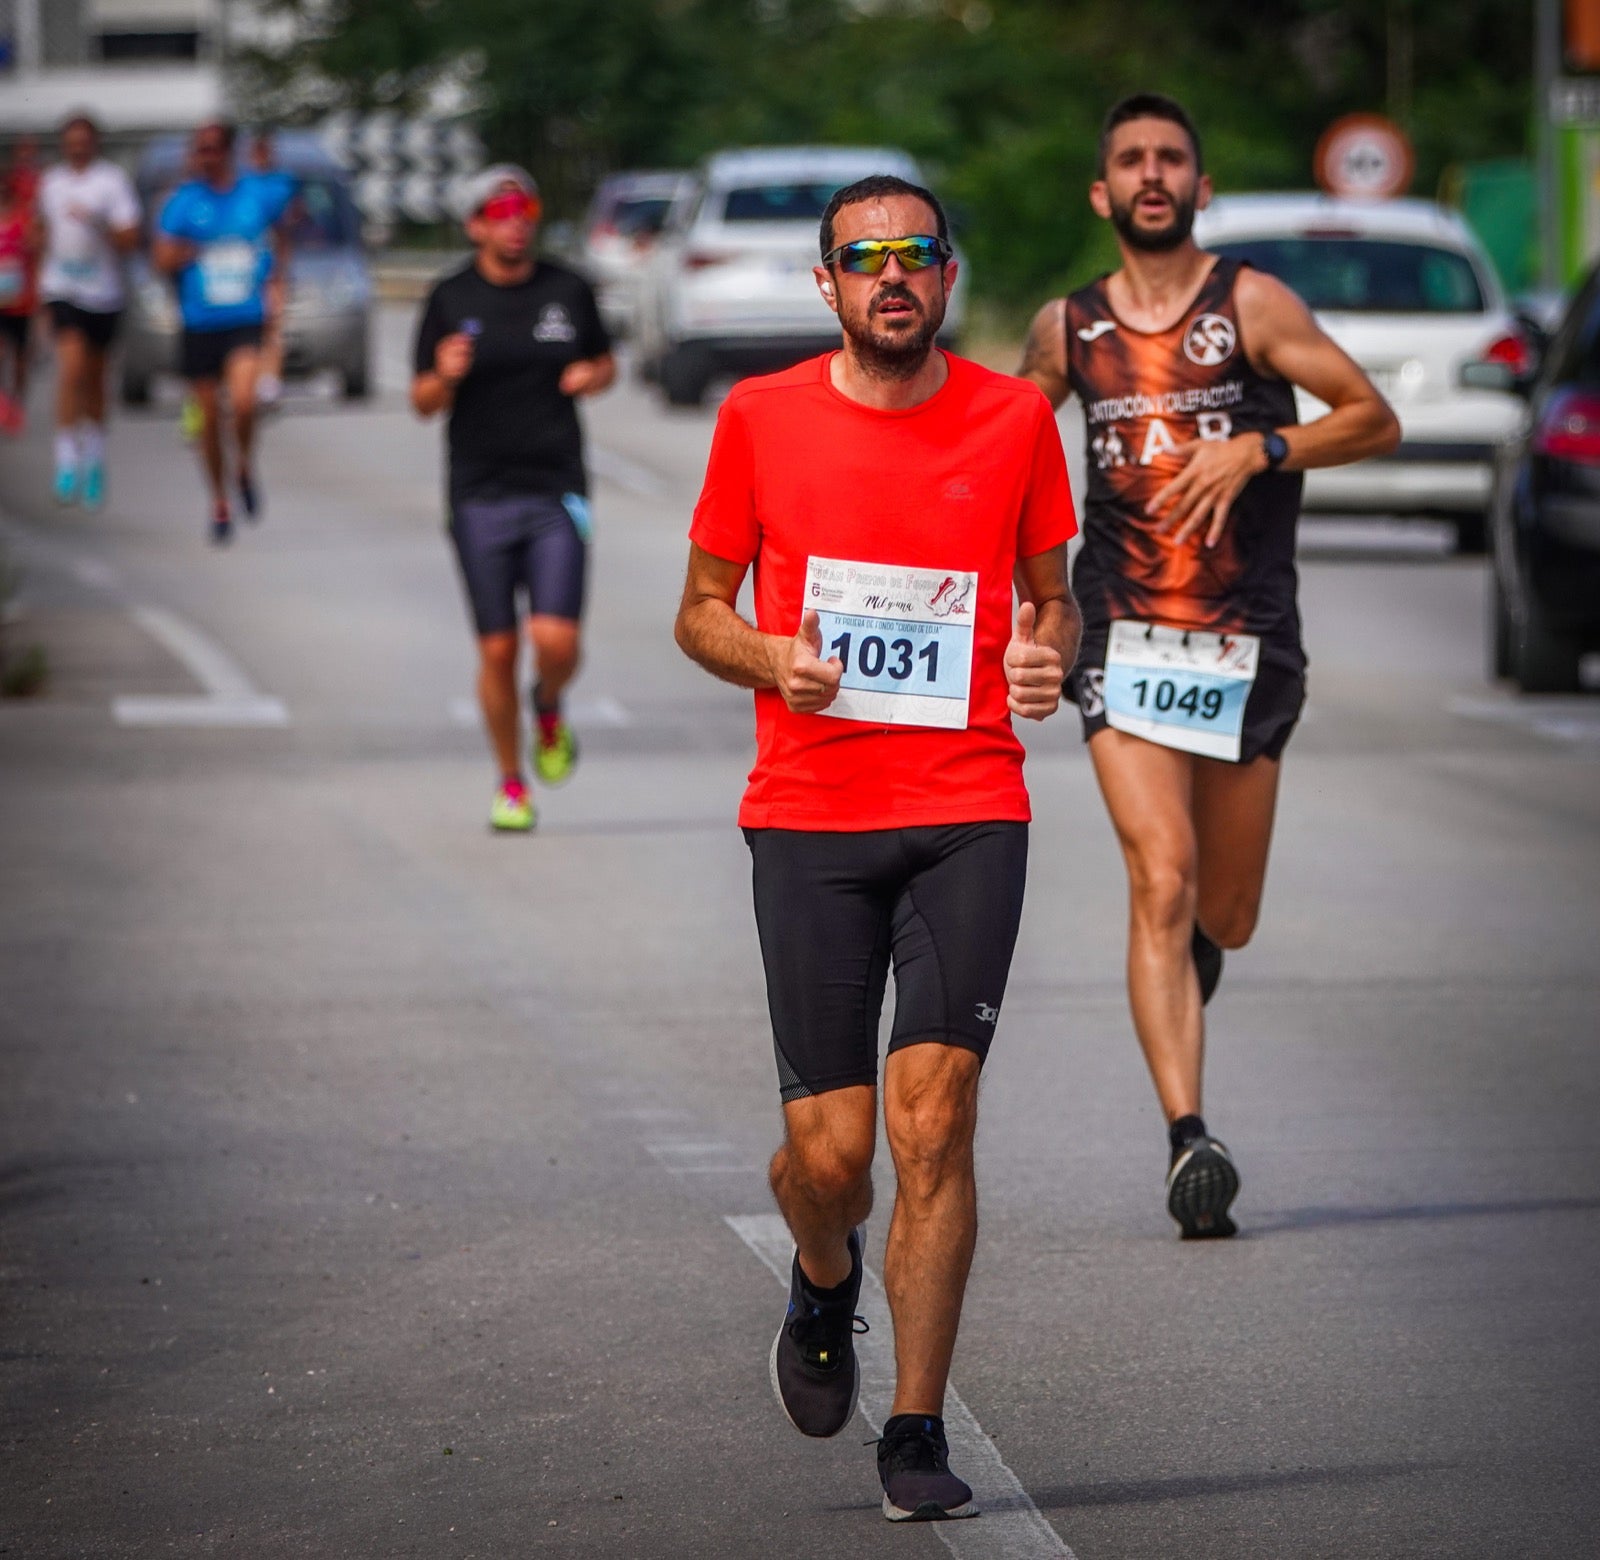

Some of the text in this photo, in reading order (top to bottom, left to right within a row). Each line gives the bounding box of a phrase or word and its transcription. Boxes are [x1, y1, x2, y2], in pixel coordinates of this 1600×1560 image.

[862, 594, 889, 610] Mil
[866, 618, 874, 628] DE
[875, 619, 895, 631] FONDO
[831, 632, 939, 682] 1031
[1132, 679, 1223, 720] 1049
